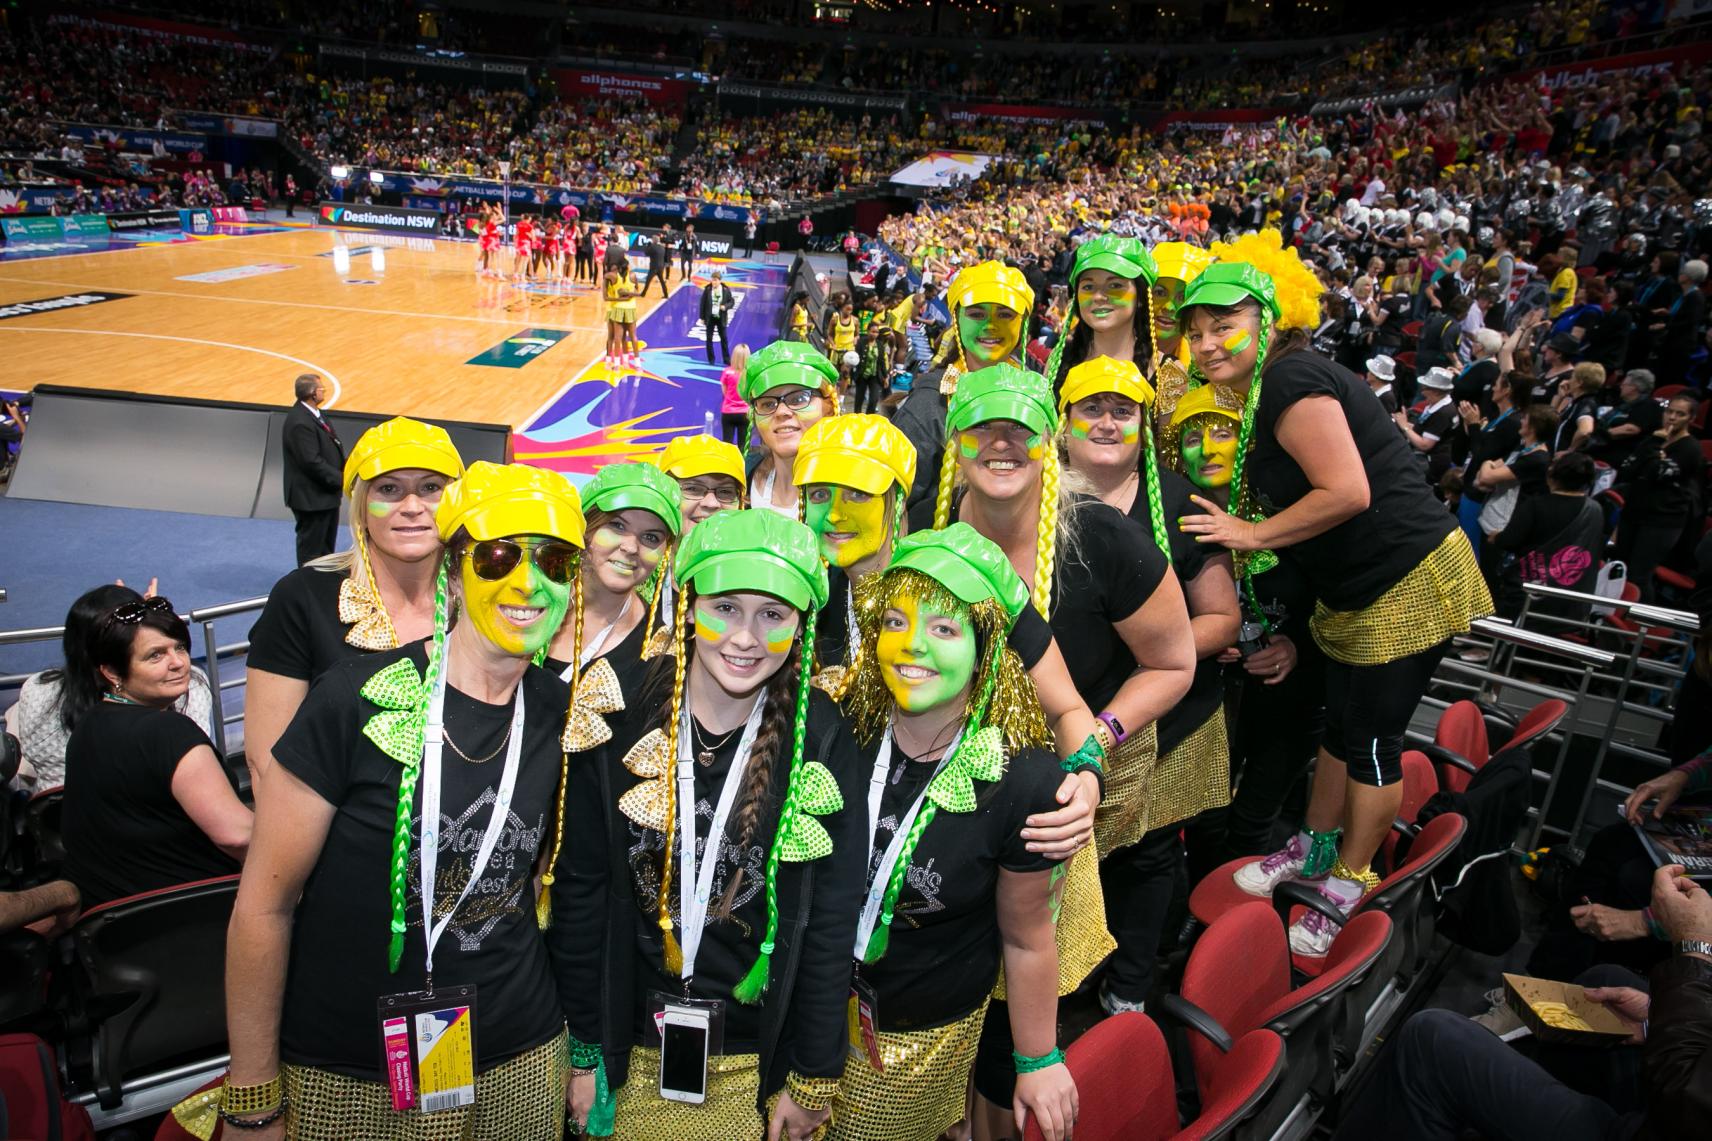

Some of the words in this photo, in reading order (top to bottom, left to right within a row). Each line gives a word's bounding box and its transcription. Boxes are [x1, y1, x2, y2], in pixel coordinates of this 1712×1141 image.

[580, 74, 662, 90] allphones
[512, 190, 527, 198] CUP
[343, 210, 405, 226] Destination
[406, 215, 435, 228] NSW
[701, 240, 730, 254] NSW
[470, 852, 503, 869] ae
[469, 871, 511, 895] est
